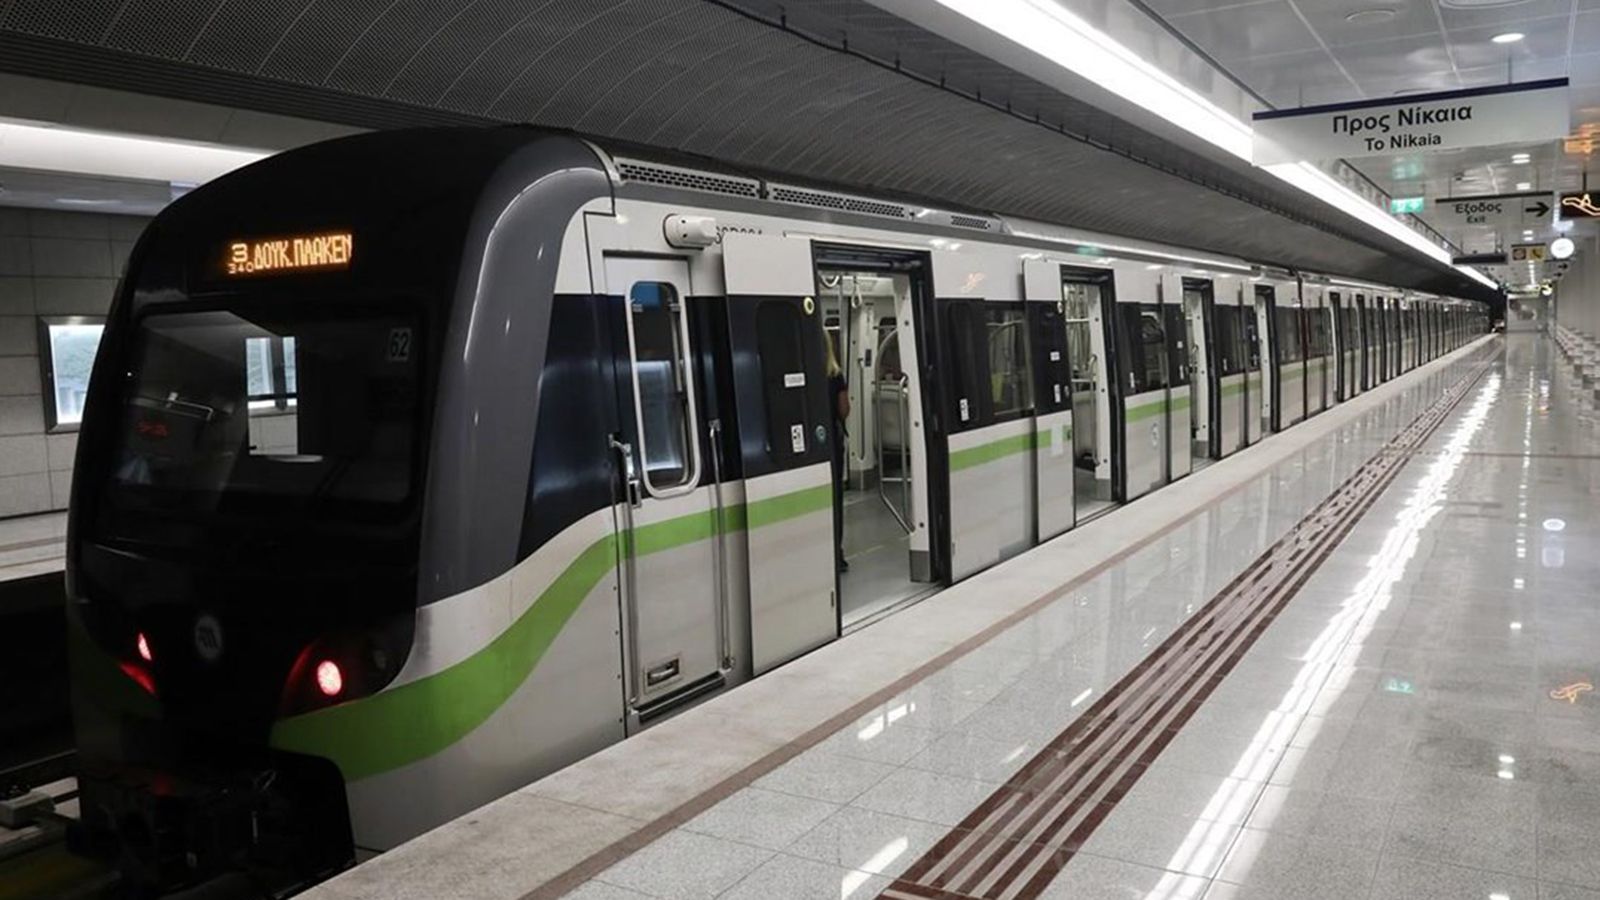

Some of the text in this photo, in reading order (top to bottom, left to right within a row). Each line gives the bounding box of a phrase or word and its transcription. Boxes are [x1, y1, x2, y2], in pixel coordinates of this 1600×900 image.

[1333, 104, 1472, 136] Προς Νίκαια
[1364, 132, 1442, 151] To Nikaia
[231, 243, 248, 263] 3
